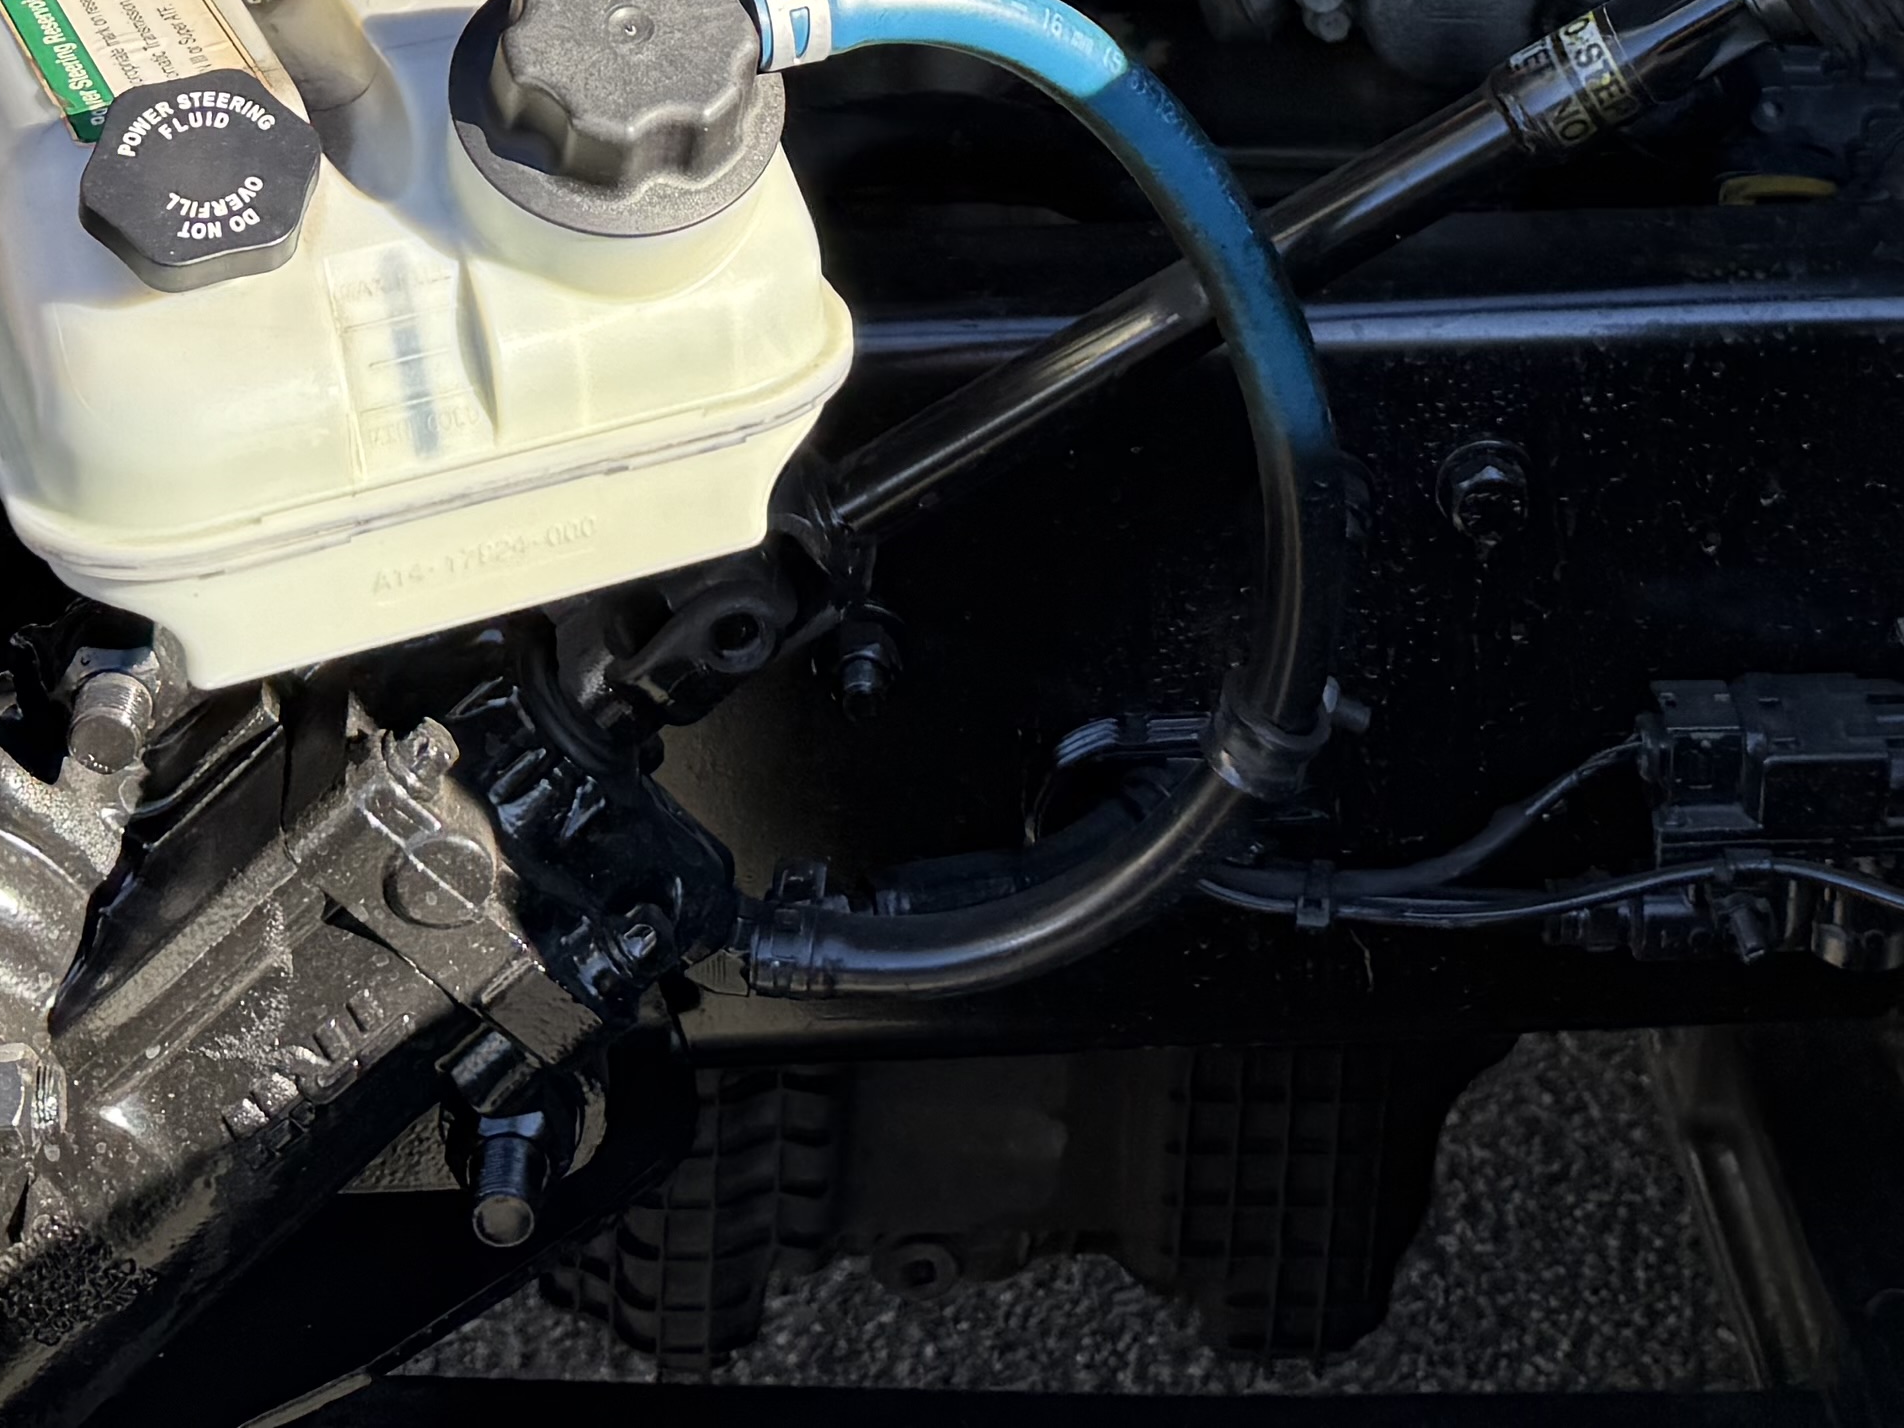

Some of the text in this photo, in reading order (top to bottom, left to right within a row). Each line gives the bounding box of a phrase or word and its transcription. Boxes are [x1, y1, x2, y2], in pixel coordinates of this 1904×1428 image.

[53, 40, 94, 92] Steering
[118, 90, 277, 157] POWER STEERING
[158, 111, 231, 141] FLUID
[166, 175, 264, 220] OVERFILL
[176, 207, 260, 240] DO NOT
